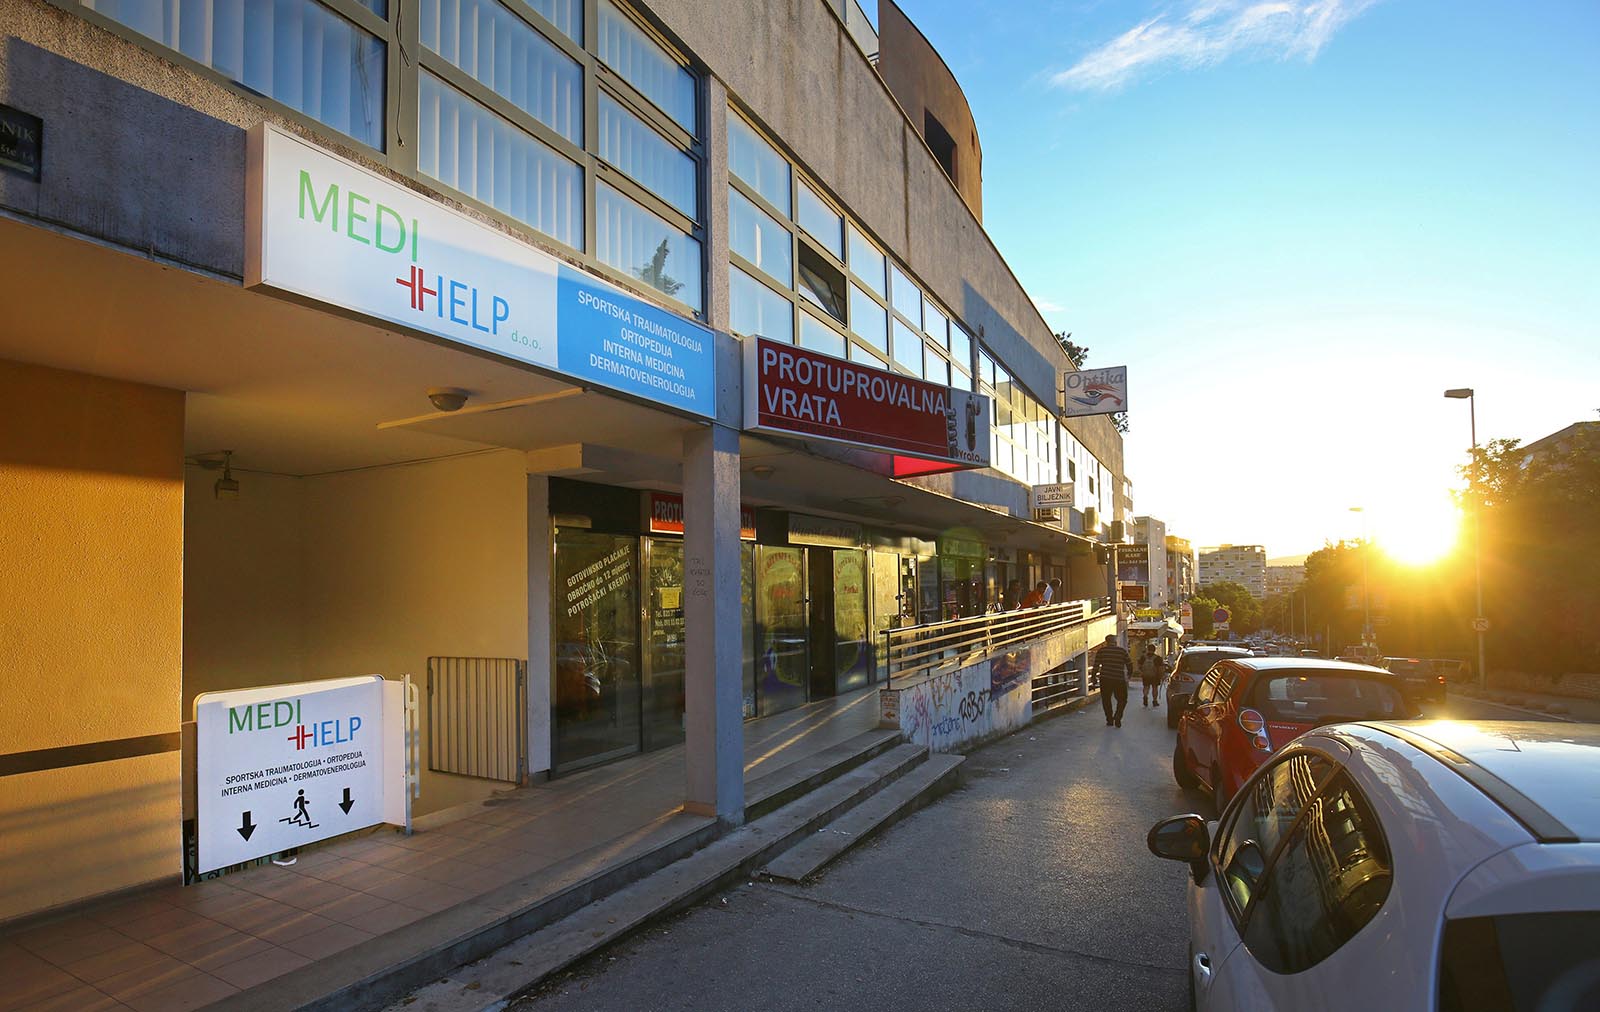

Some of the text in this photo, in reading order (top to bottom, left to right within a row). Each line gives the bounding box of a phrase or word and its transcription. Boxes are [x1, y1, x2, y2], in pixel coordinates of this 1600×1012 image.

[298, 169, 419, 263] MEDI
[396, 264, 543, 351] HELP d.o.o.
[577, 290, 704, 355] SPORTSKA TRAUMATOLOGIJA
[603, 338, 686, 381] INTERNA MEDICINA
[620, 327, 674, 359] ORTOPEDIJA
[589, 352, 696, 400] DERMATOVENEROLOGIJA
[762, 347, 947, 417] PROTUPROVALNA
[1067, 370, 1124, 391] Optika
[763, 383, 843, 427] VRATA
[1036, 493, 1072, 502] BILJEŽNIK
[1044, 485, 1063, 494] JAVNI
[566, 560, 604, 587] GOTOVINSKO
[595, 576, 604, 586] do
[603, 569, 612, 580] 12
[607, 571, 632, 592] KREDITI
[228, 698, 301, 735] MEDI
[287, 716, 362, 751] HELP
[221, 759, 367, 798] INTERNA MEDICINA DERMATOVENEROLOGIJA
[225, 750, 363, 785] SPORTSKA TRAUMATOLOGIJA ORTOPEDIJA
